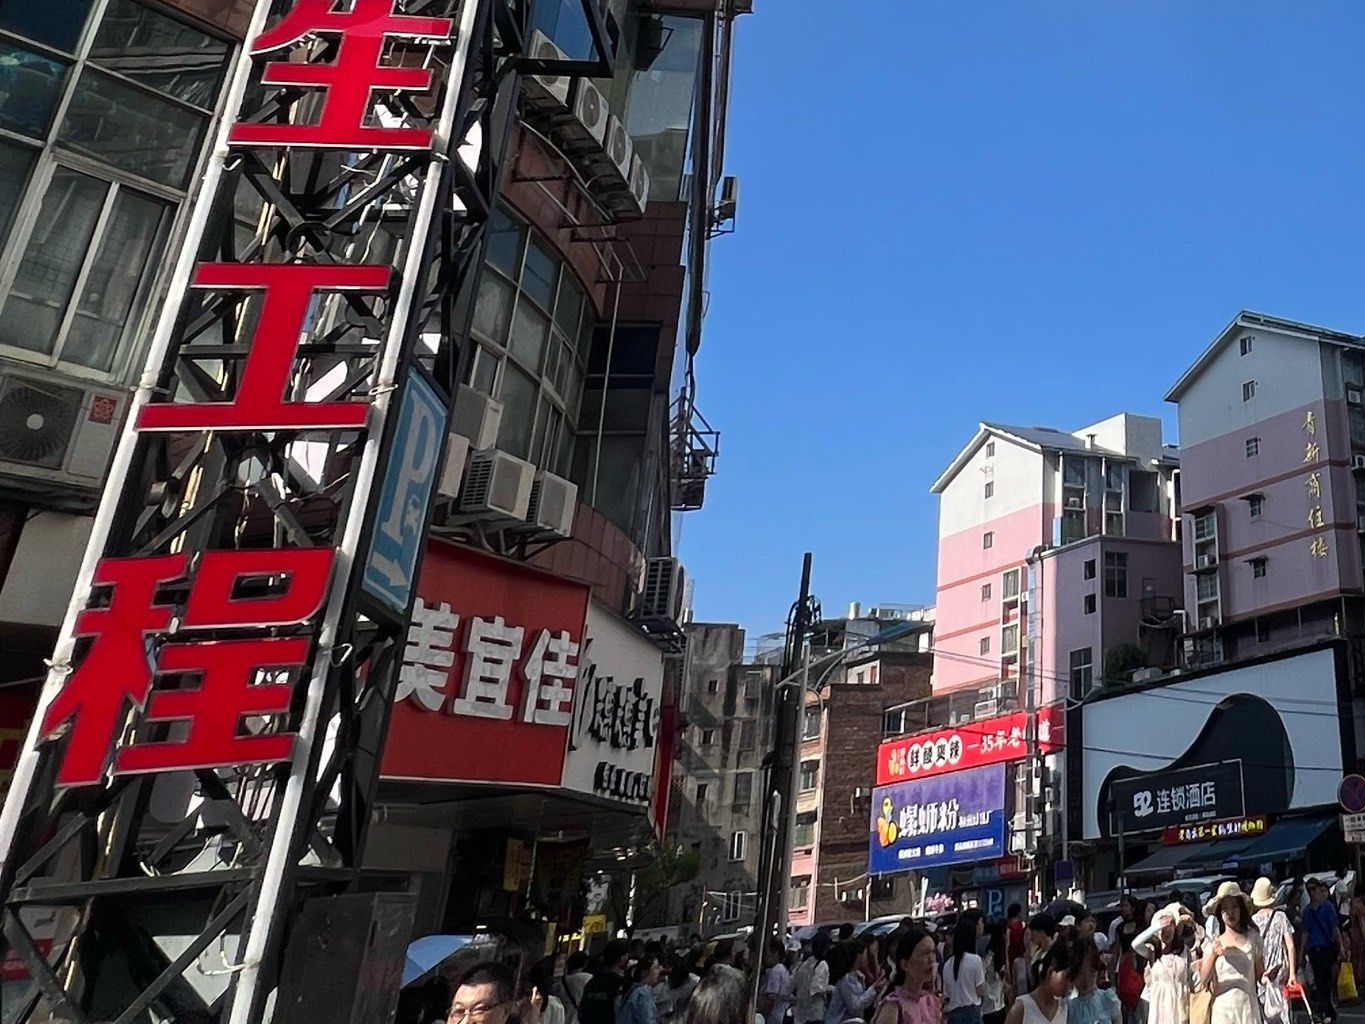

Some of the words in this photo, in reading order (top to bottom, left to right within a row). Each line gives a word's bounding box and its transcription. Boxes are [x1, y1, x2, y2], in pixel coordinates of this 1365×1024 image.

[395, 596, 580, 728] 美宜佳
[1156, 780, 1217, 814] 连锁酒店
[899, 798, 960, 839] 螺蛳粉
